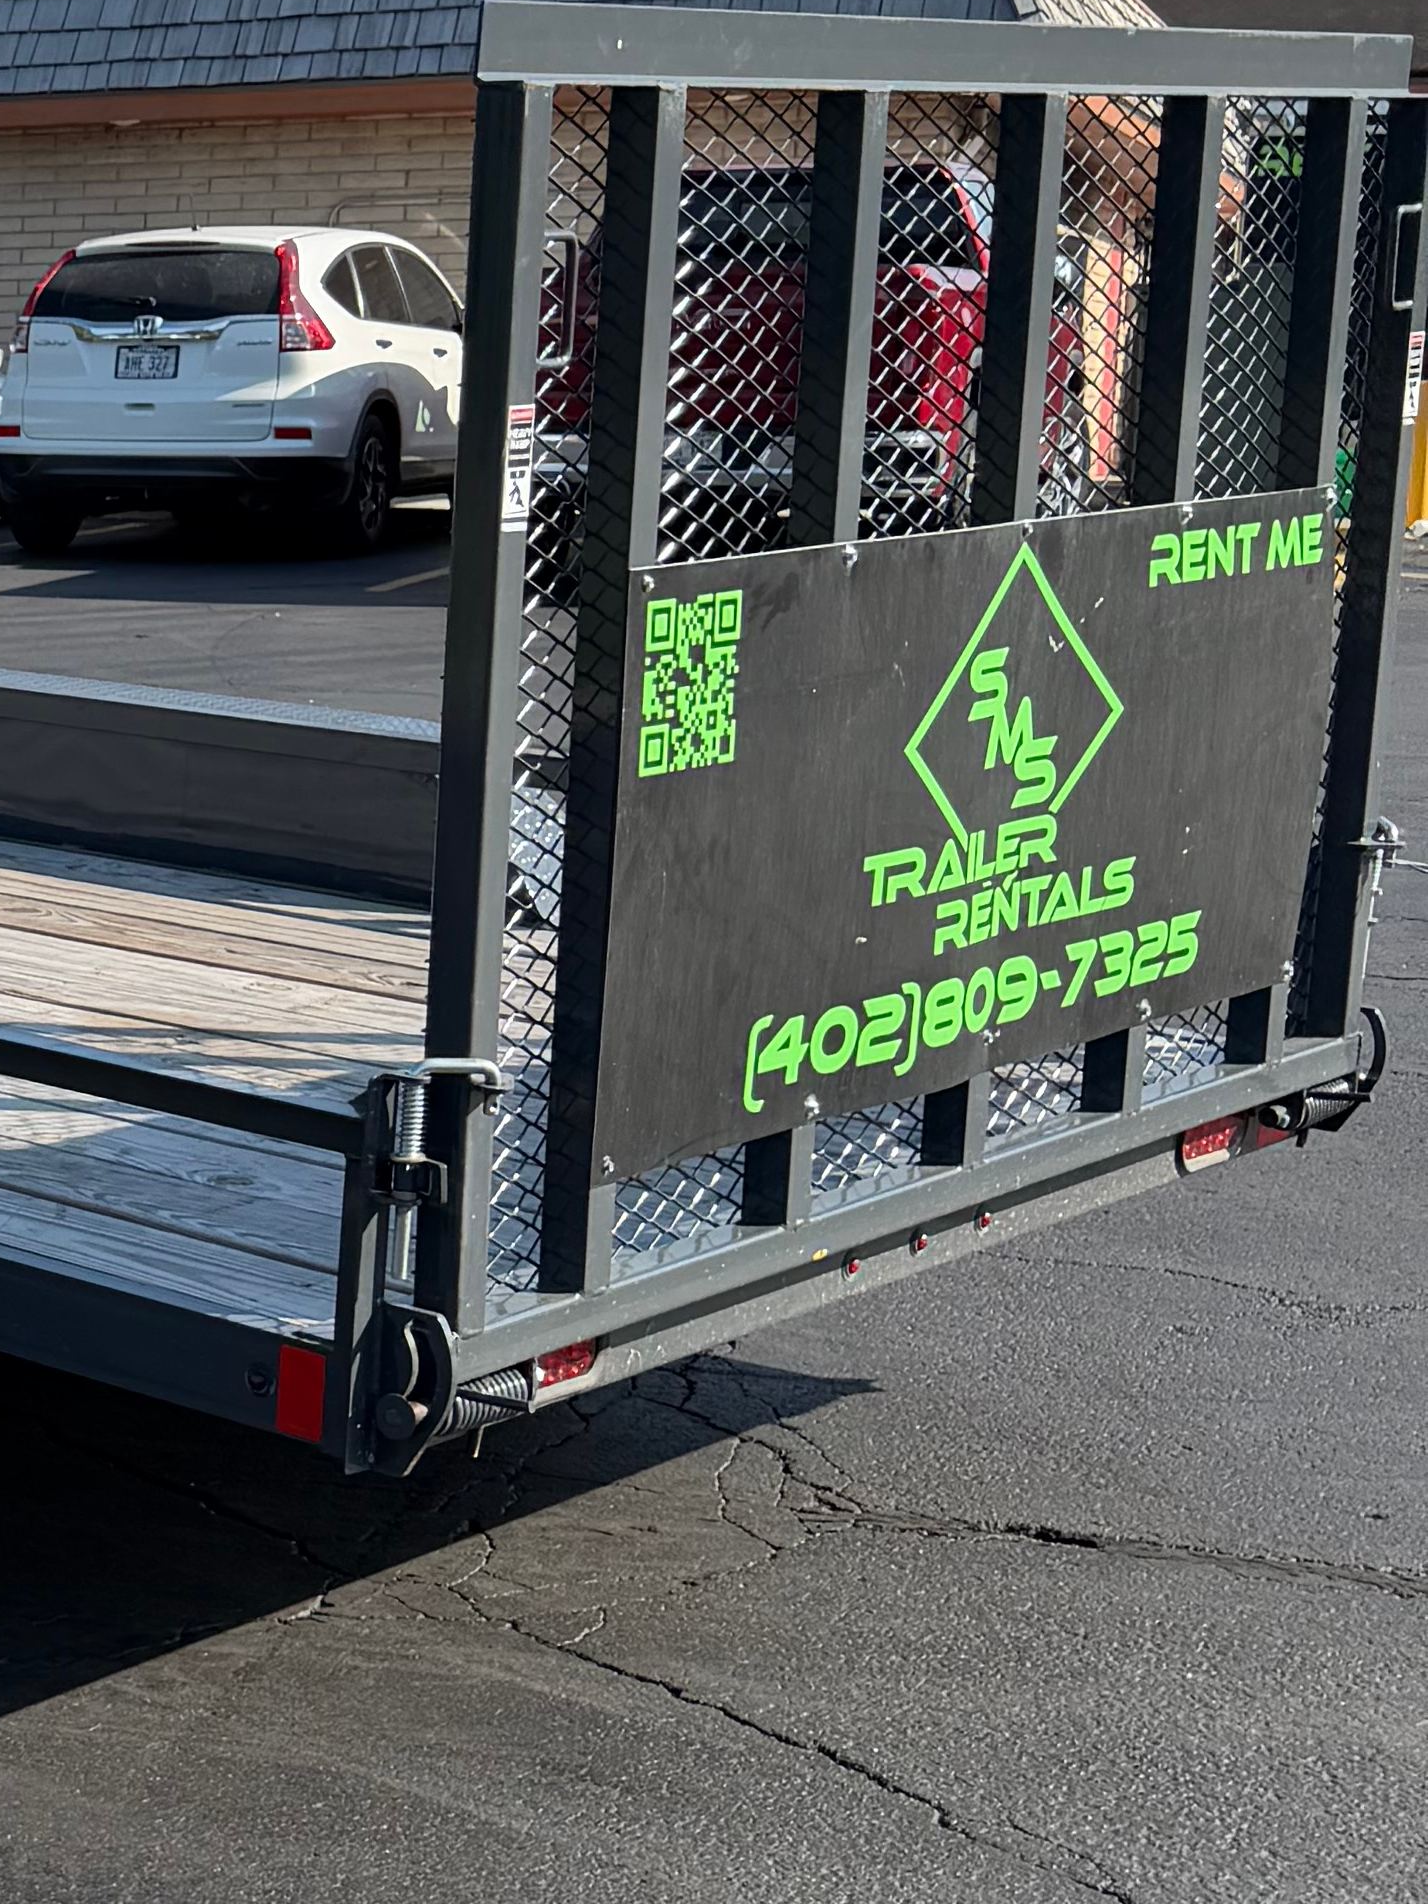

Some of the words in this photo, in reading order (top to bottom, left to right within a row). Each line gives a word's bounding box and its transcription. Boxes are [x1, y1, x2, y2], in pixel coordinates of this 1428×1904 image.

[1148, 522, 1261, 587] RENT
[1265, 513, 1323, 569] ME
[968, 646, 1058, 809] SMS
[863, 814, 1058, 907] TRAILER
[933, 856, 1136, 956] RENTALS
[743, 911, 1201, 1114] (402)809-7325
